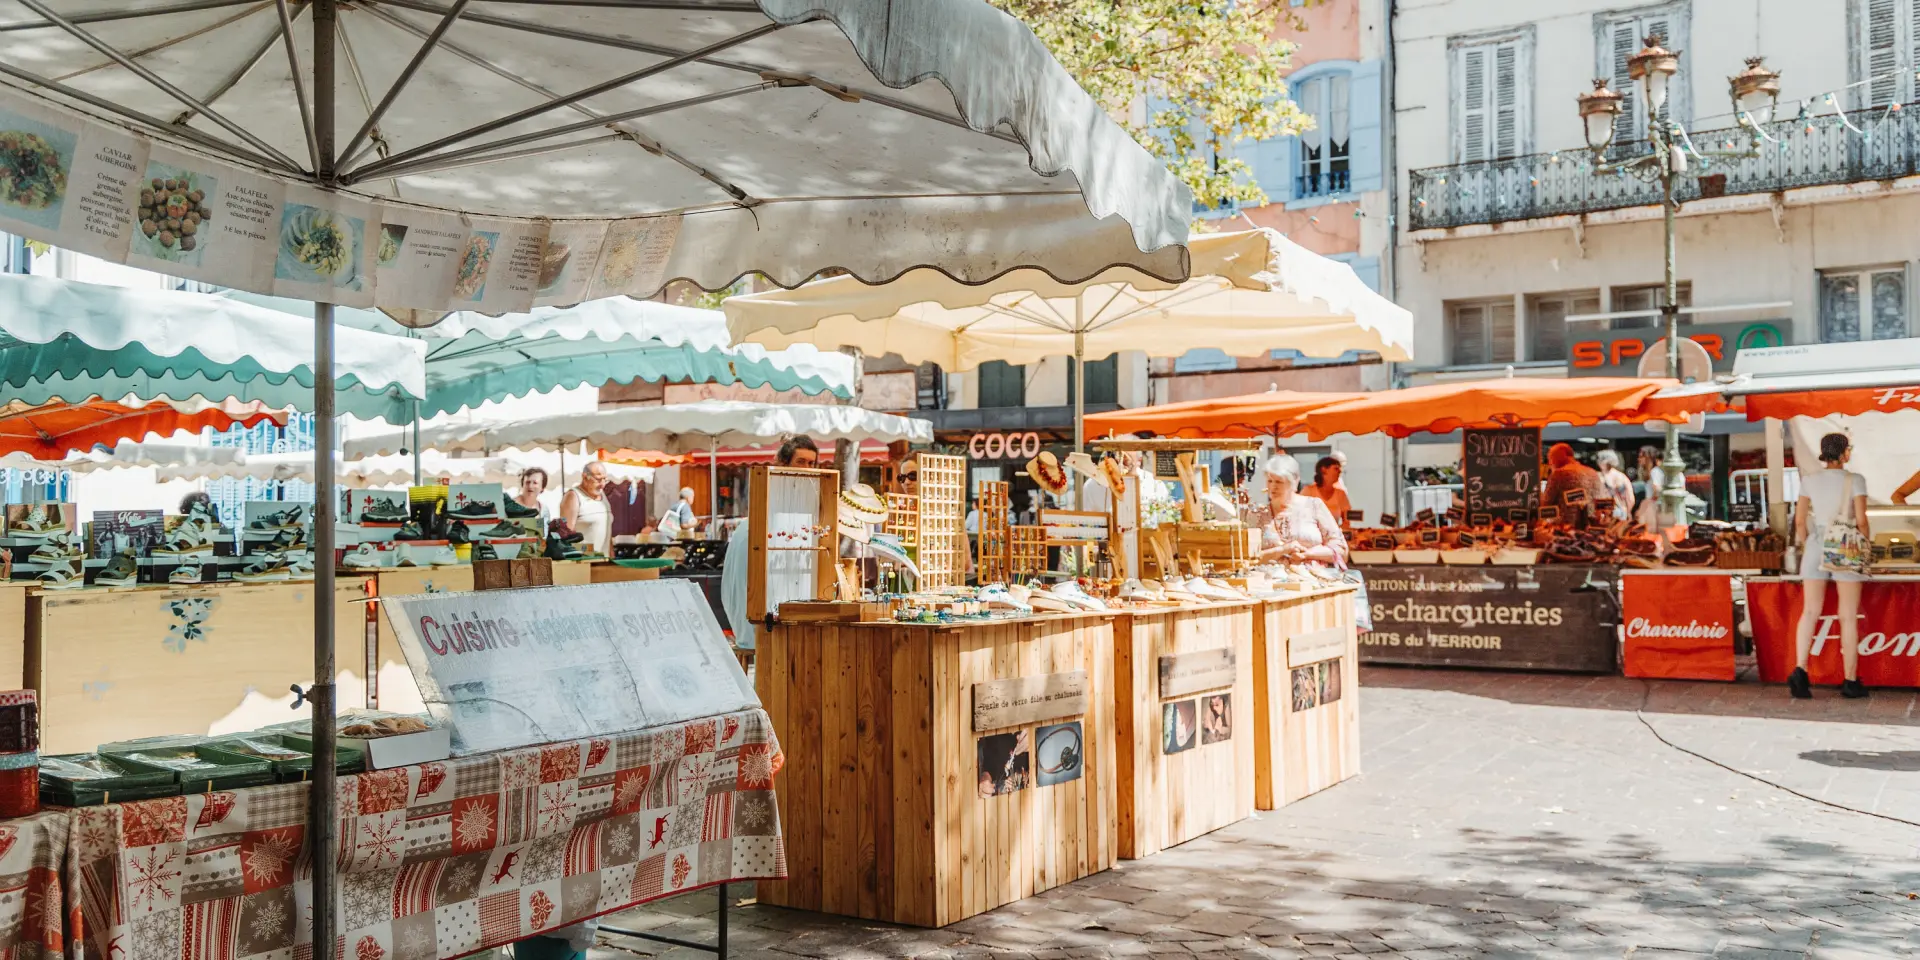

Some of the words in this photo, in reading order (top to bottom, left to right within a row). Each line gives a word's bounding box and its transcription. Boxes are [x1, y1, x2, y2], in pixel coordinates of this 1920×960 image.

[103, 146, 132, 161] CAVIAR
[93, 153, 137, 172] AUBERGINE
[225, 191, 239, 201] Avec
[240, 196, 252, 204] pois
[235, 185, 268, 200] FALAFELS
[80, 196, 105, 208] poivron
[106, 203, 124, 214] rouge
[263, 209, 271, 217] de
[111, 222, 120, 230] ail
[115, 214, 130, 225] huile
[95, 226, 102, 234] la
[1572, 333, 1723, 369] SPR
[1871, 386, 1920, 405] Fr
[969, 431, 1040, 460] COCO
[1468, 476, 1483, 494] 3
[1469, 495, 1484, 511] 5
[1369, 579, 1409, 592] RITON
[1368, 597, 1563, 626] s-charcuteries
[420, 610, 521, 656] Cuisine
[1626, 617, 1729, 639] Charcuterie
[1405, 634, 1424, 647] du
[1430, 634, 1502, 650] TERROIR
[1001, 699, 1009, 708] de
